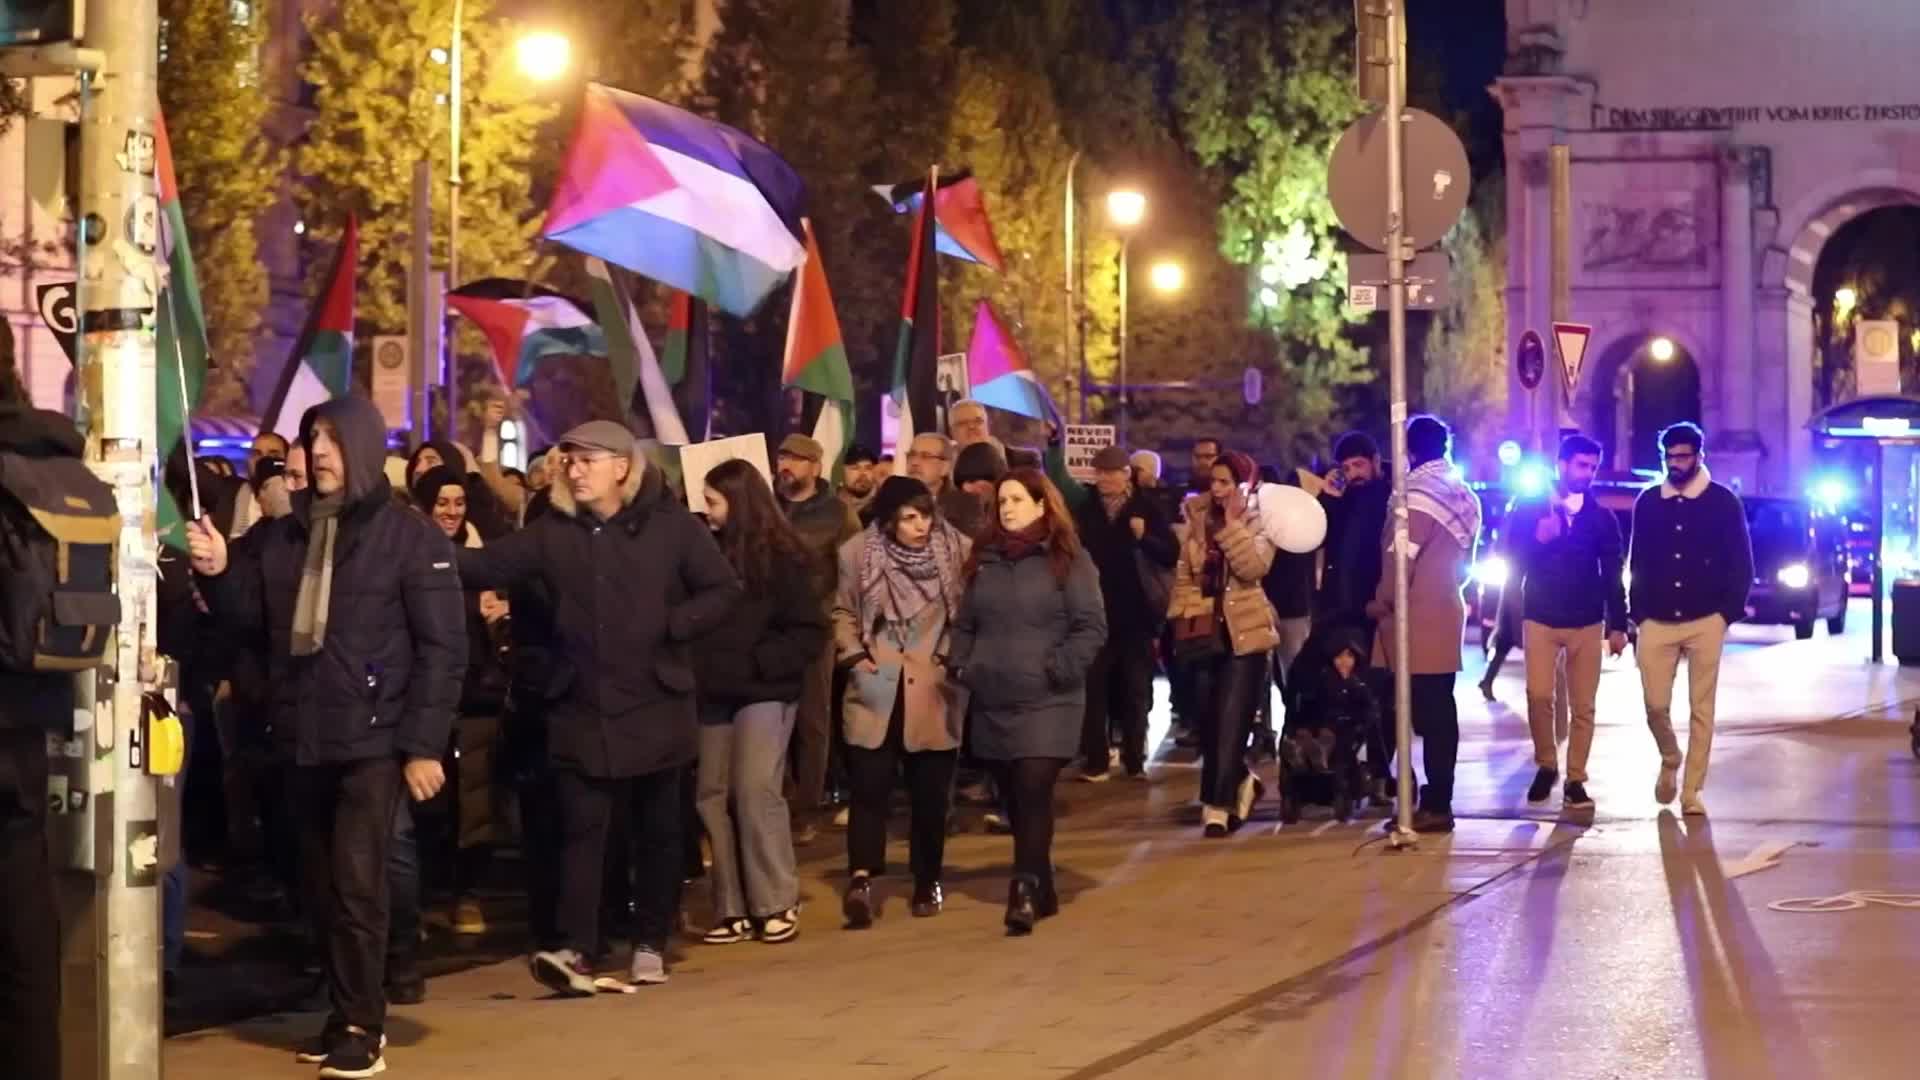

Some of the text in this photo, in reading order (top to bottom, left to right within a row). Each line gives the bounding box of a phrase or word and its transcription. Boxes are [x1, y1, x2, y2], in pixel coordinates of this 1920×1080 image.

[1767, 105, 1809, 122] VOM
[1813, 105, 1861, 121] KRIEG
[1067, 427, 1111, 436] NEVER
[1068, 437, 1111, 446] AGAIN
